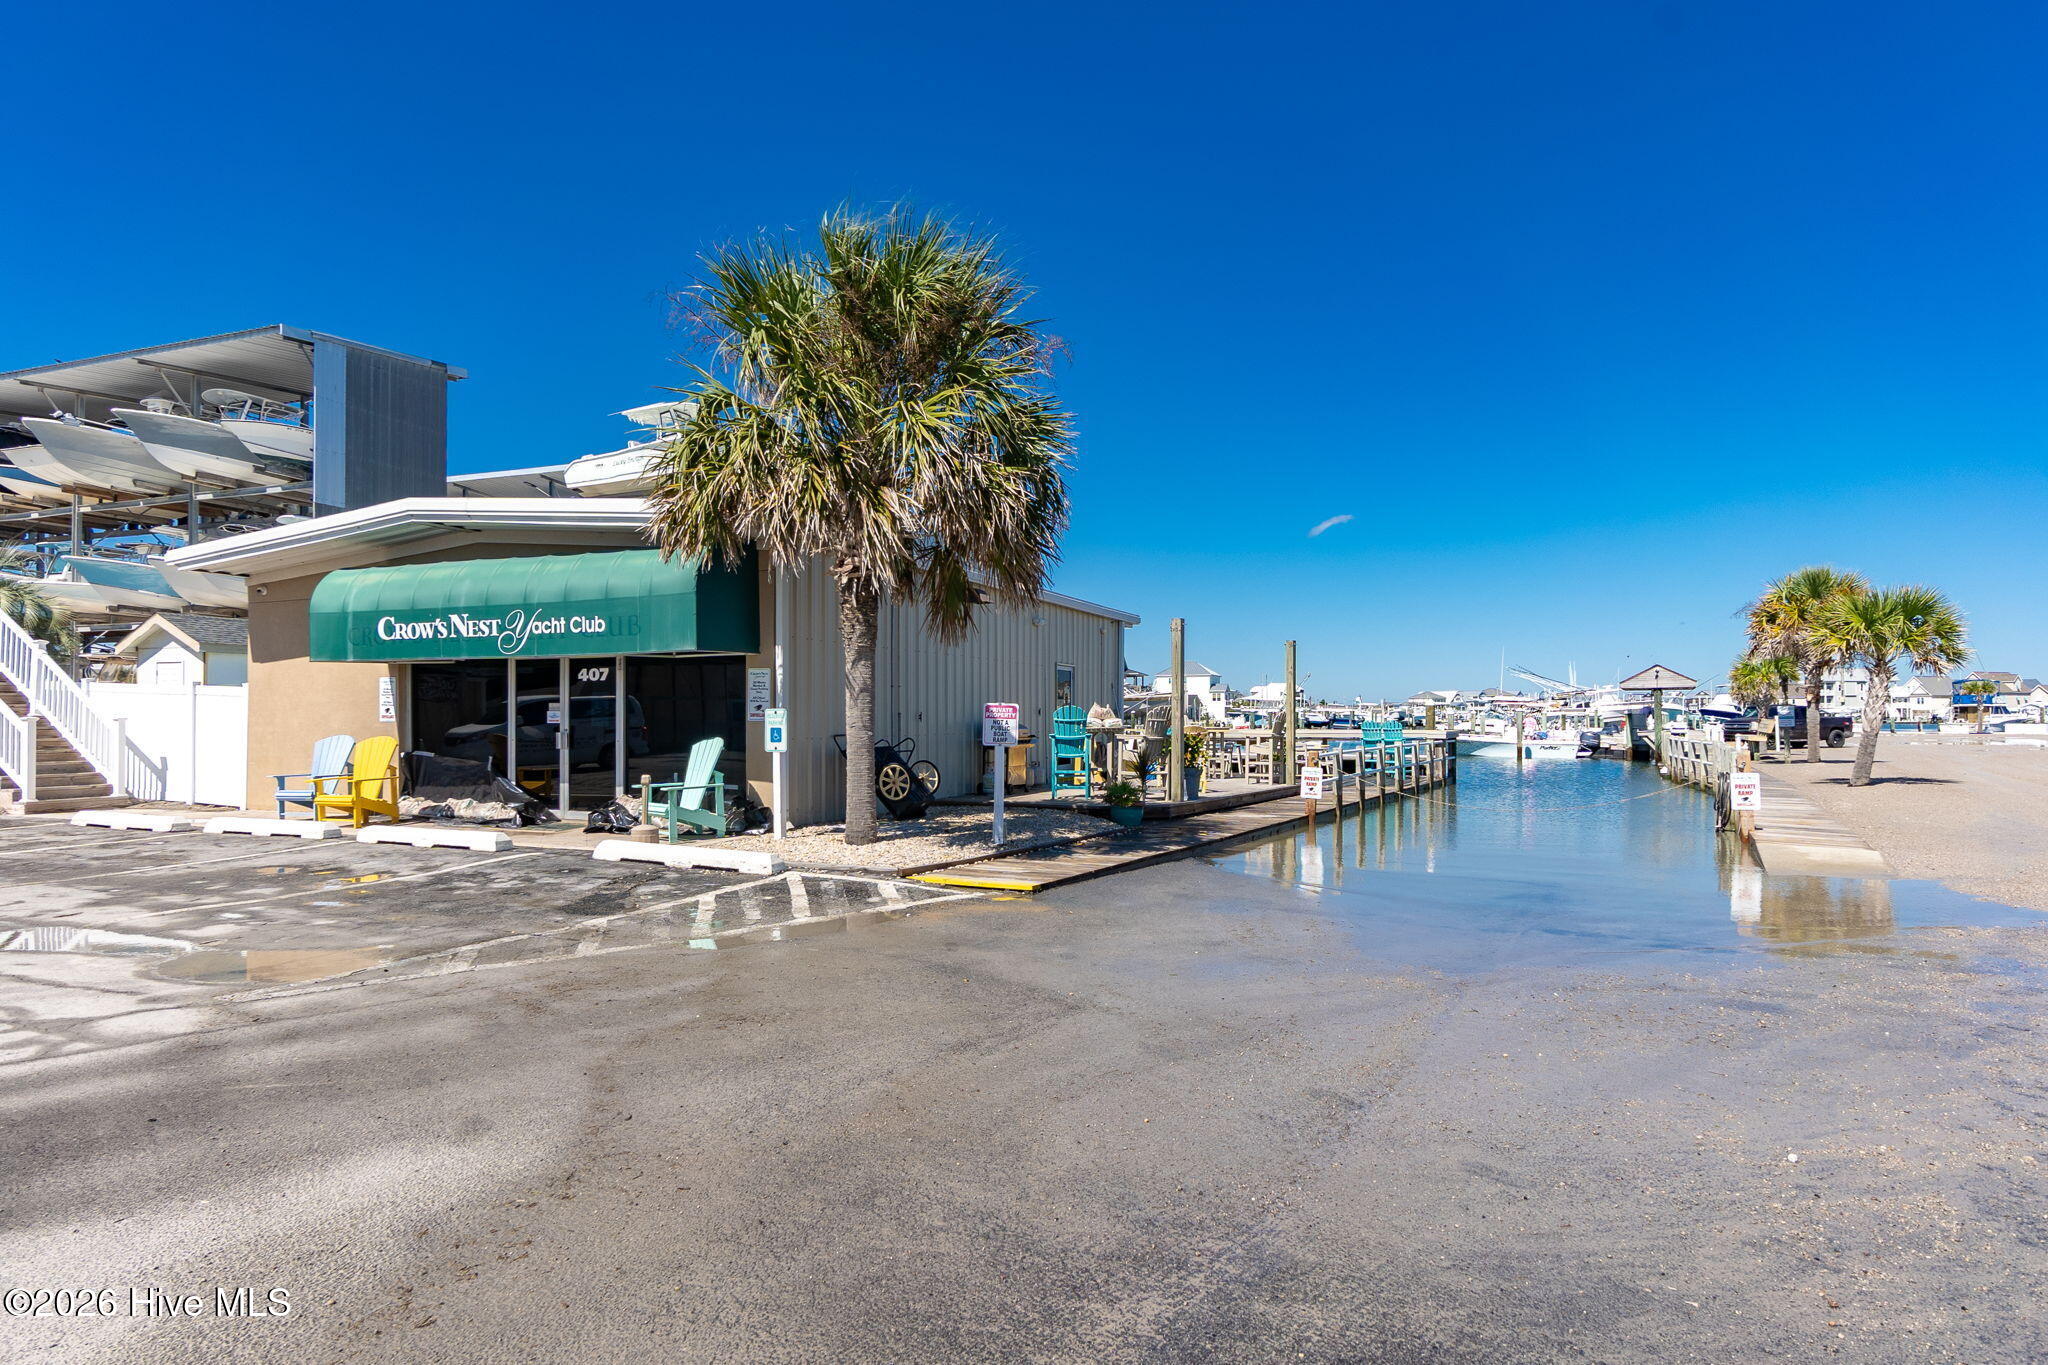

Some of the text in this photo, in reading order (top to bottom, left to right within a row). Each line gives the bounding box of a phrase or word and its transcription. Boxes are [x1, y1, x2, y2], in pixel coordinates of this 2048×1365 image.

[449, 613, 501, 639] NEST
[498, 608, 566, 655] Yacht
[569, 615, 606, 634] Club
[577, 667, 609, 682] 407
